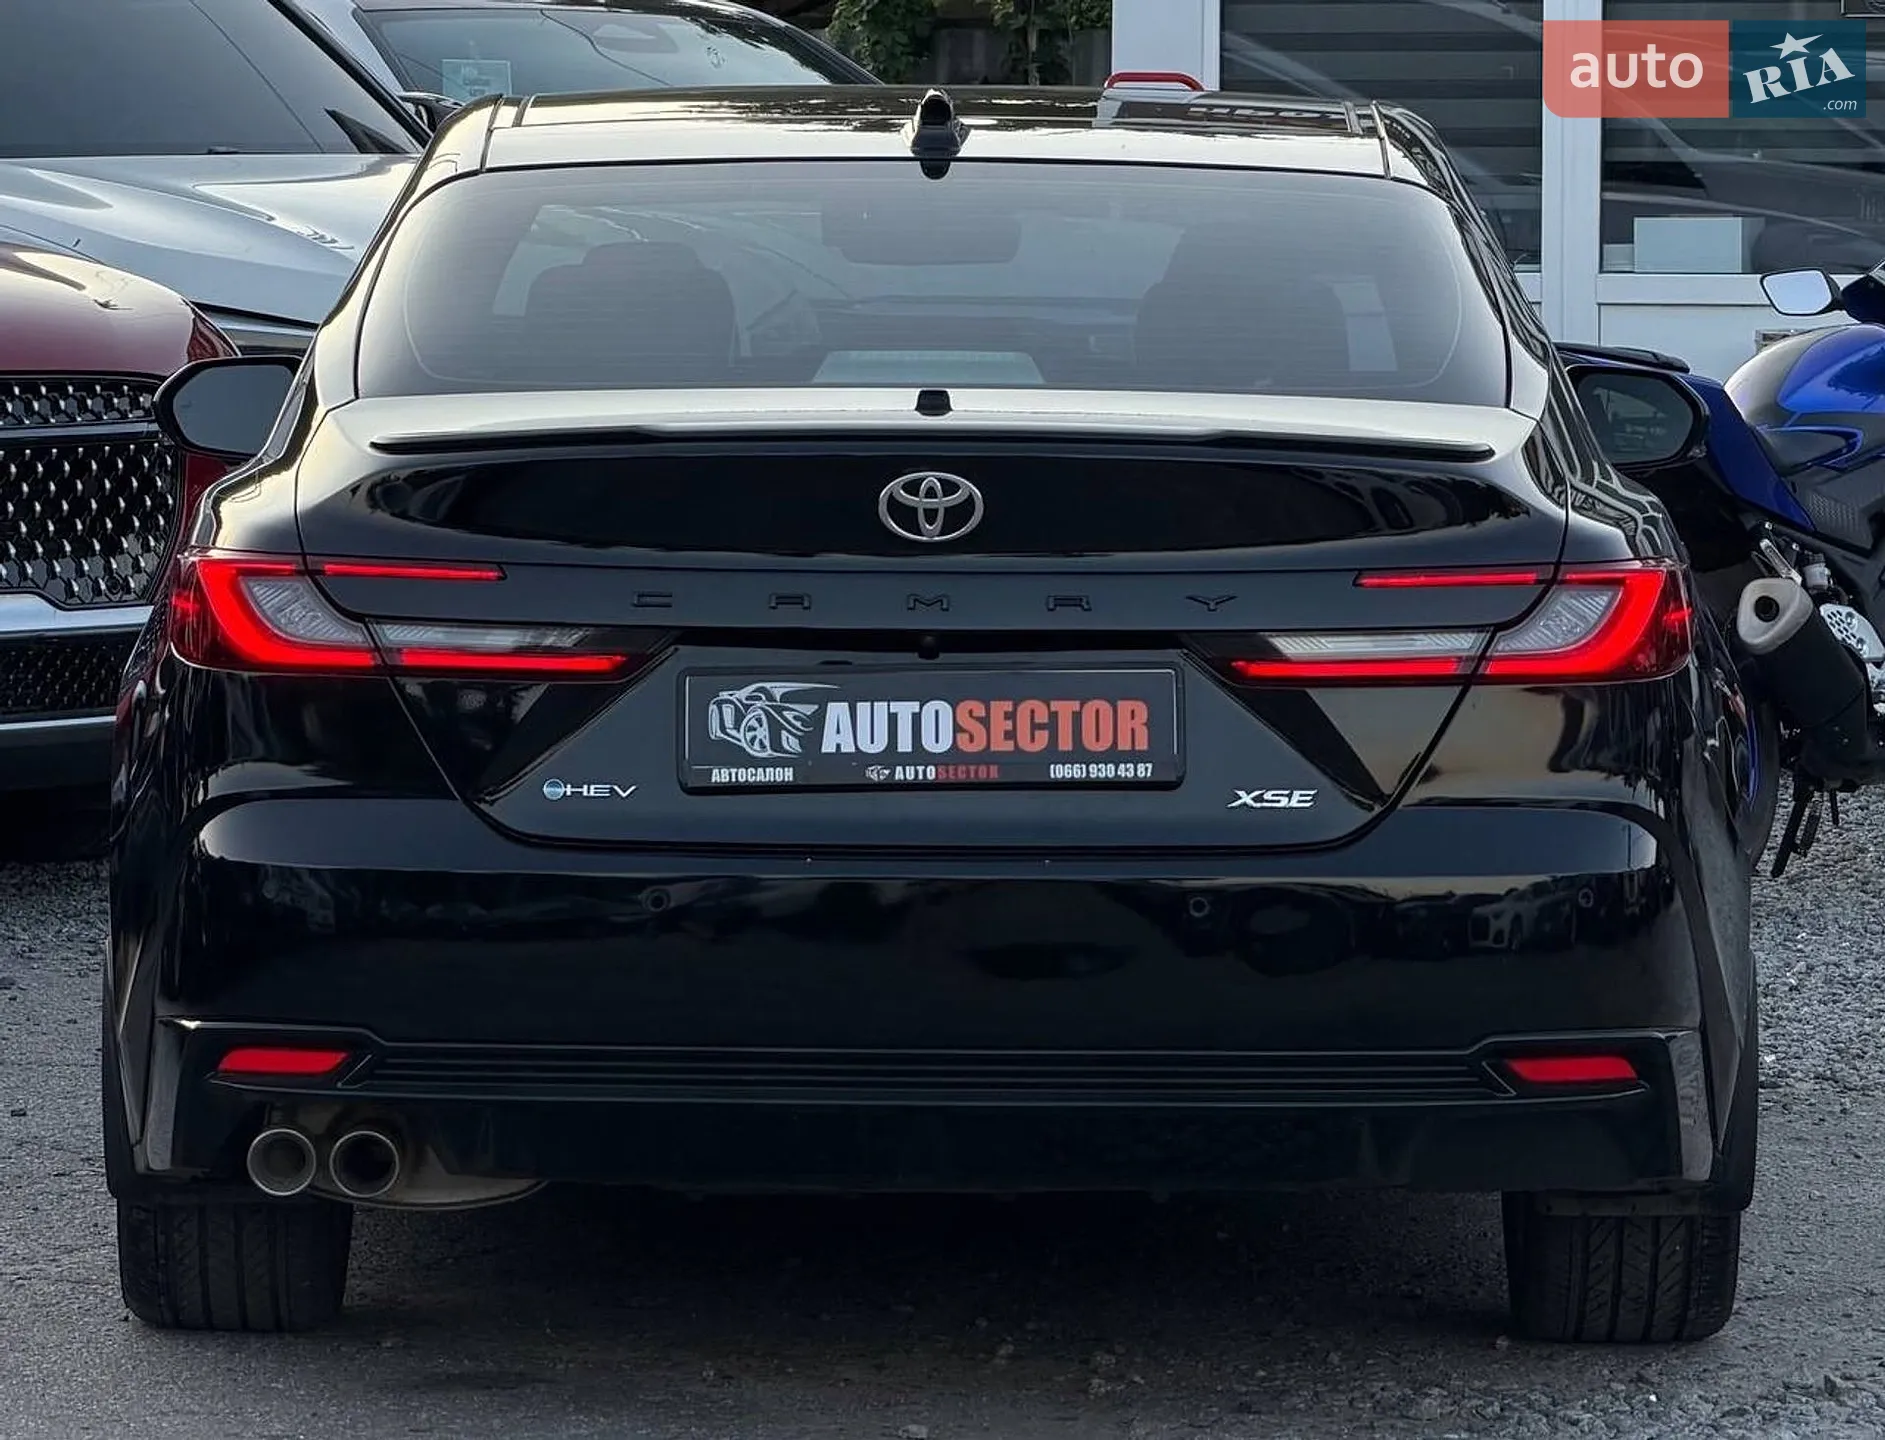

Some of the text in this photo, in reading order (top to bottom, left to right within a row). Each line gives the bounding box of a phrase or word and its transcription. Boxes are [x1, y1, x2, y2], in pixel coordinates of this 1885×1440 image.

[820, 699, 1149, 754] AUTOSECTOR
[711, 767, 794, 782] АВТОСАЛОН
[1049, 763, 1153, 778] (066) 930 43 87
[1227, 789, 1318, 808] XSE
